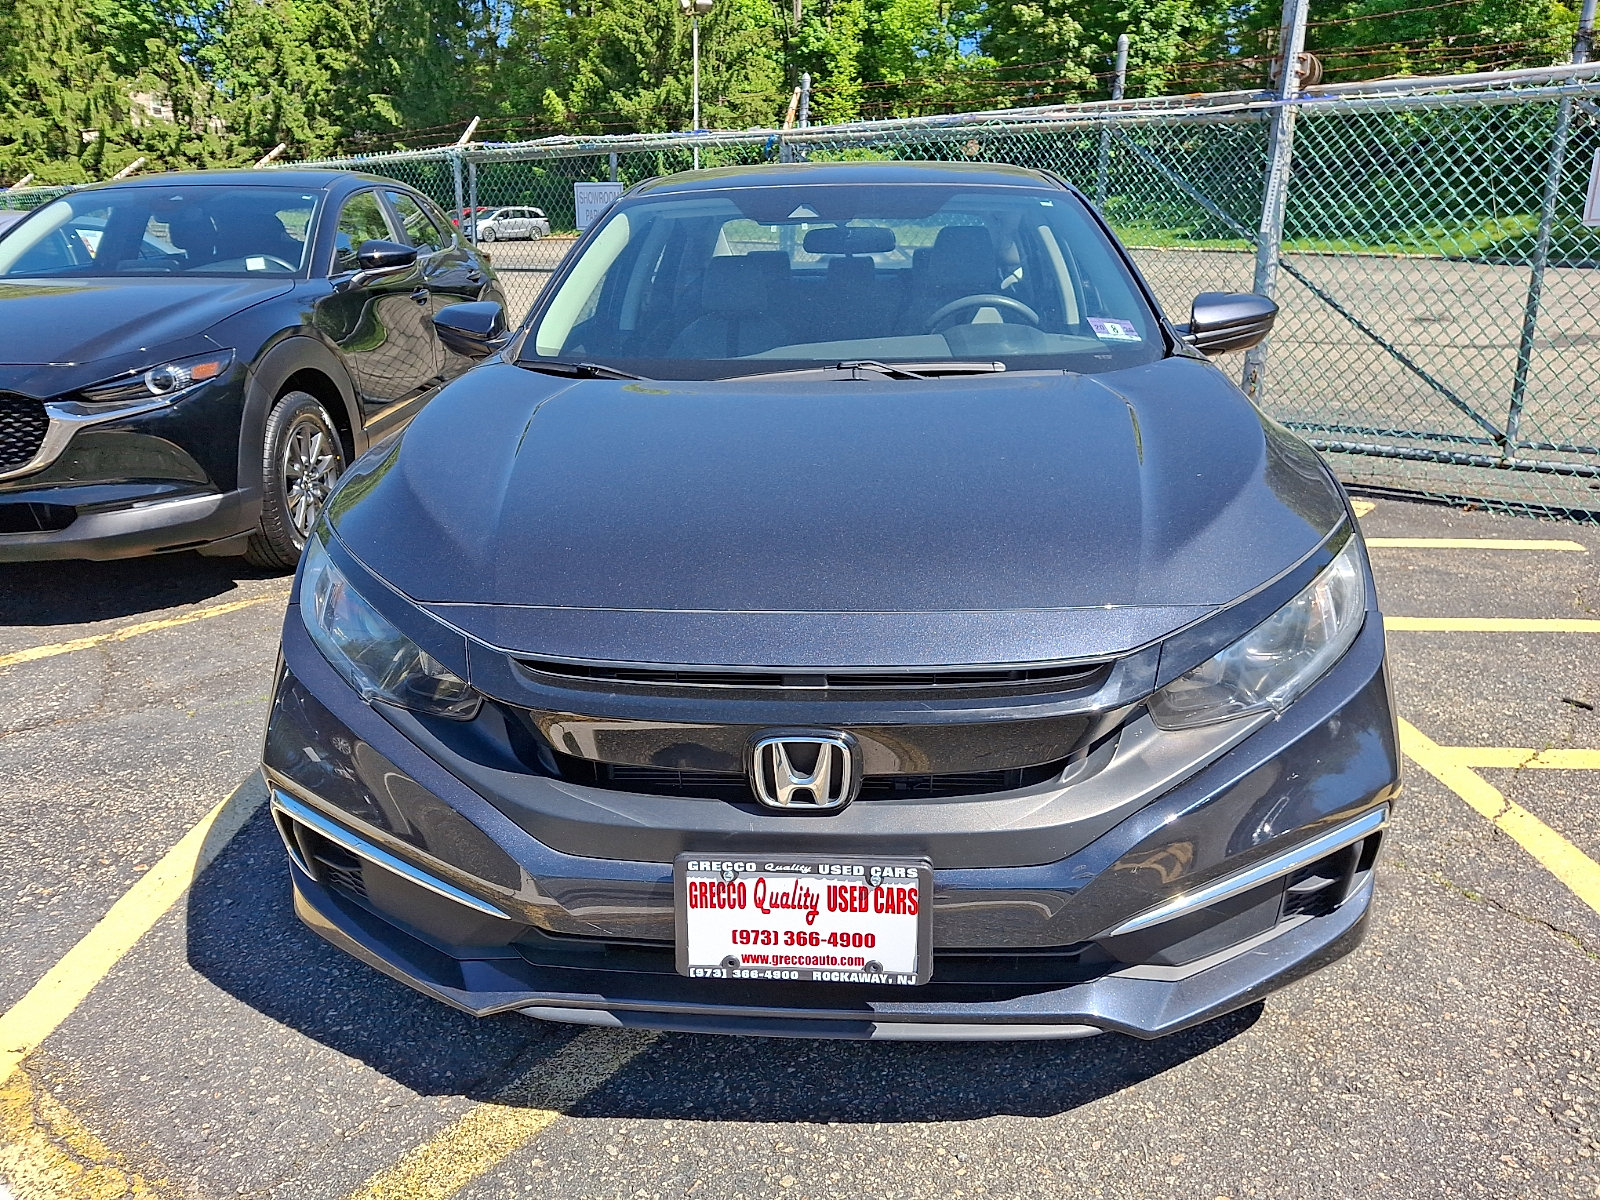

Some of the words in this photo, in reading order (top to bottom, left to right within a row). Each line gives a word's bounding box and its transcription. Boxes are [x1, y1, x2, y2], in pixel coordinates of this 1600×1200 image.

[687, 860, 757, 872] GRECCO
[764, 862, 812, 874] Quality
[818, 864, 865, 876] USED
[870, 866, 918, 878] CARS
[688, 881, 747, 910] GRECCO
[753, 876, 820, 926] Quality
[826, 884, 869, 913] USED
[873, 886, 918, 916] CARS
[783, 930, 876, 949] 366-4900
[740, 954, 865, 967] www.greccoauto.com
[732, 969, 799, 980] 366-4900
[812, 970, 893, 984] ROCKAWAY,
[897, 974, 917, 985] NJ
